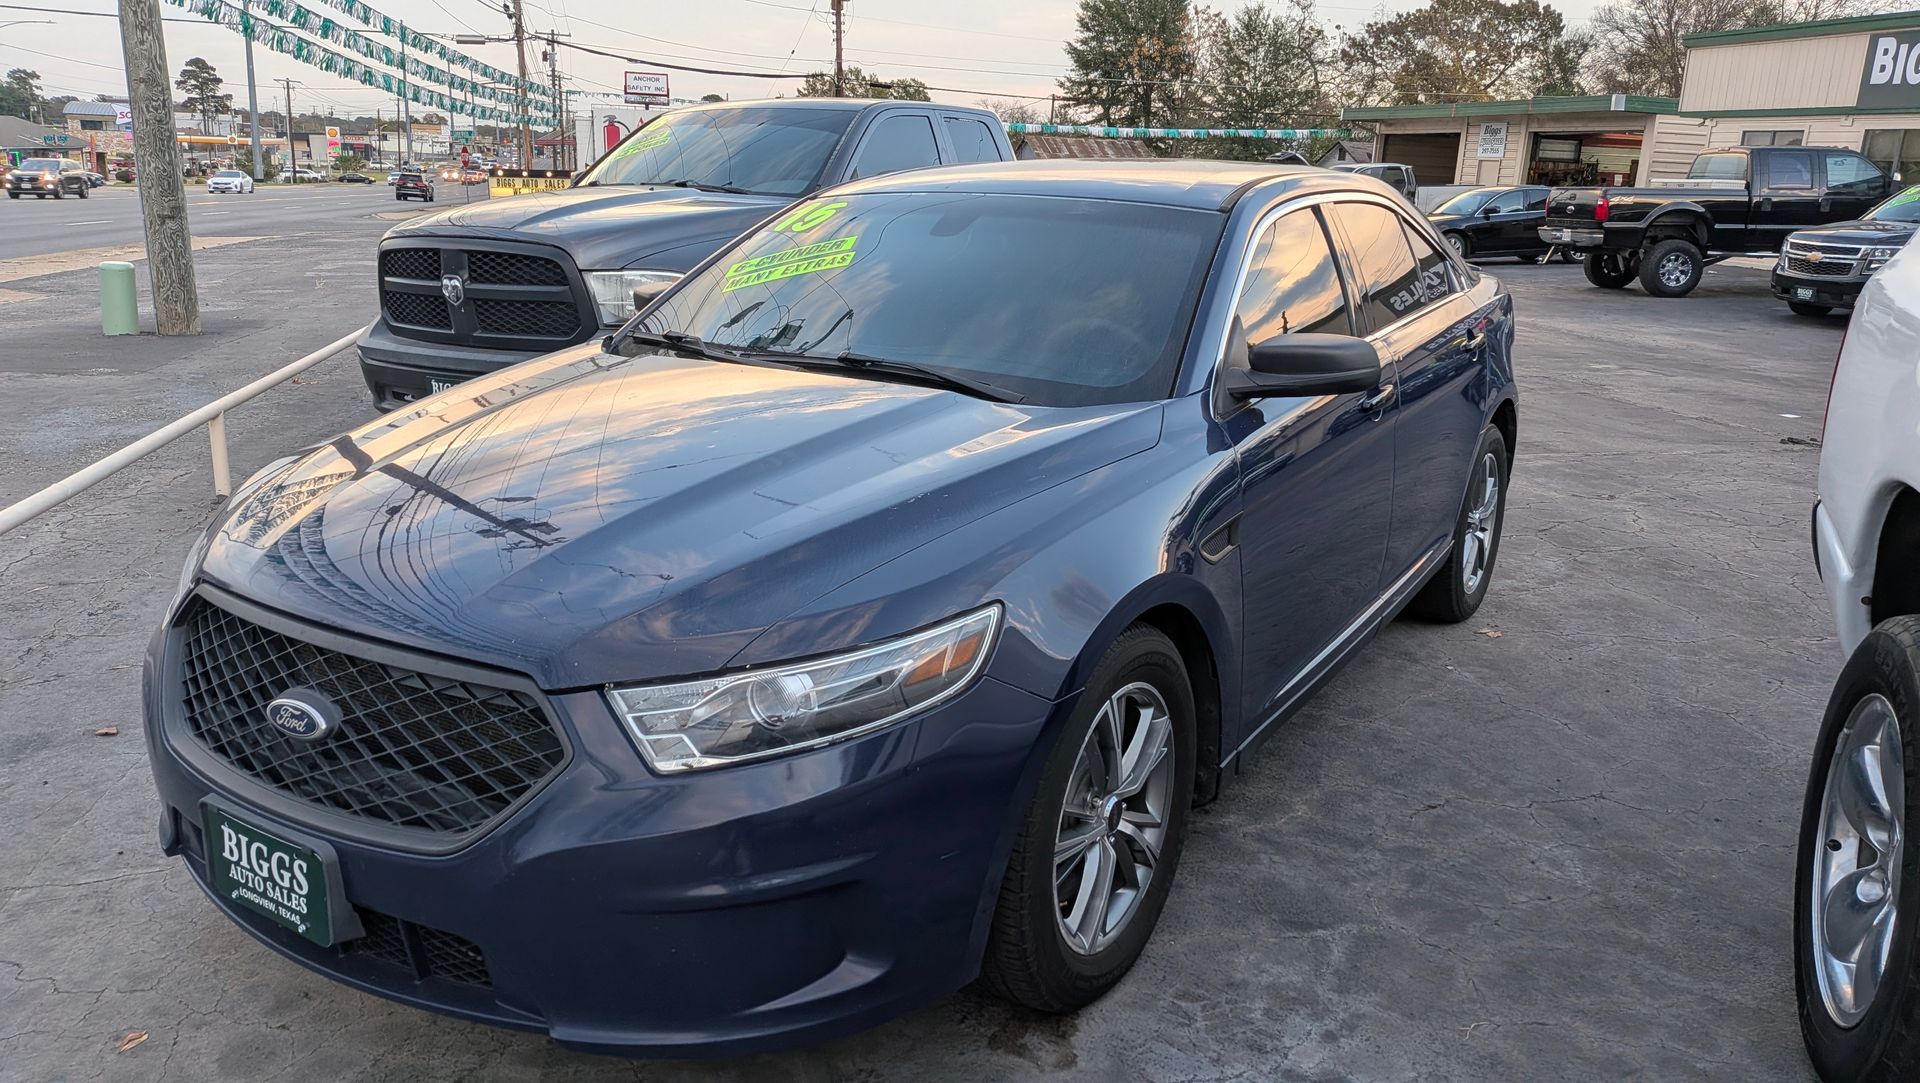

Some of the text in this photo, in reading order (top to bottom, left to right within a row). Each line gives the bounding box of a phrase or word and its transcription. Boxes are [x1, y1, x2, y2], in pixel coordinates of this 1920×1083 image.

[633, 75, 661, 83] ANCHOR
[1484, 124, 1503, 138] Biggs
[496, 178, 565, 189] BIGGS AUTO SALES
[774, 201, 849, 232] 15
[725, 253, 852, 290] MANY EXTRAS
[733, 239, 847, 273] 6-CYLINDER
[276, 705, 309, 732] Ford
[221, 824, 309, 896] BIGGS
[229, 863, 308, 914] AUTO SALES
[239, 886, 301, 925] LONGVIEW, TEXAS
